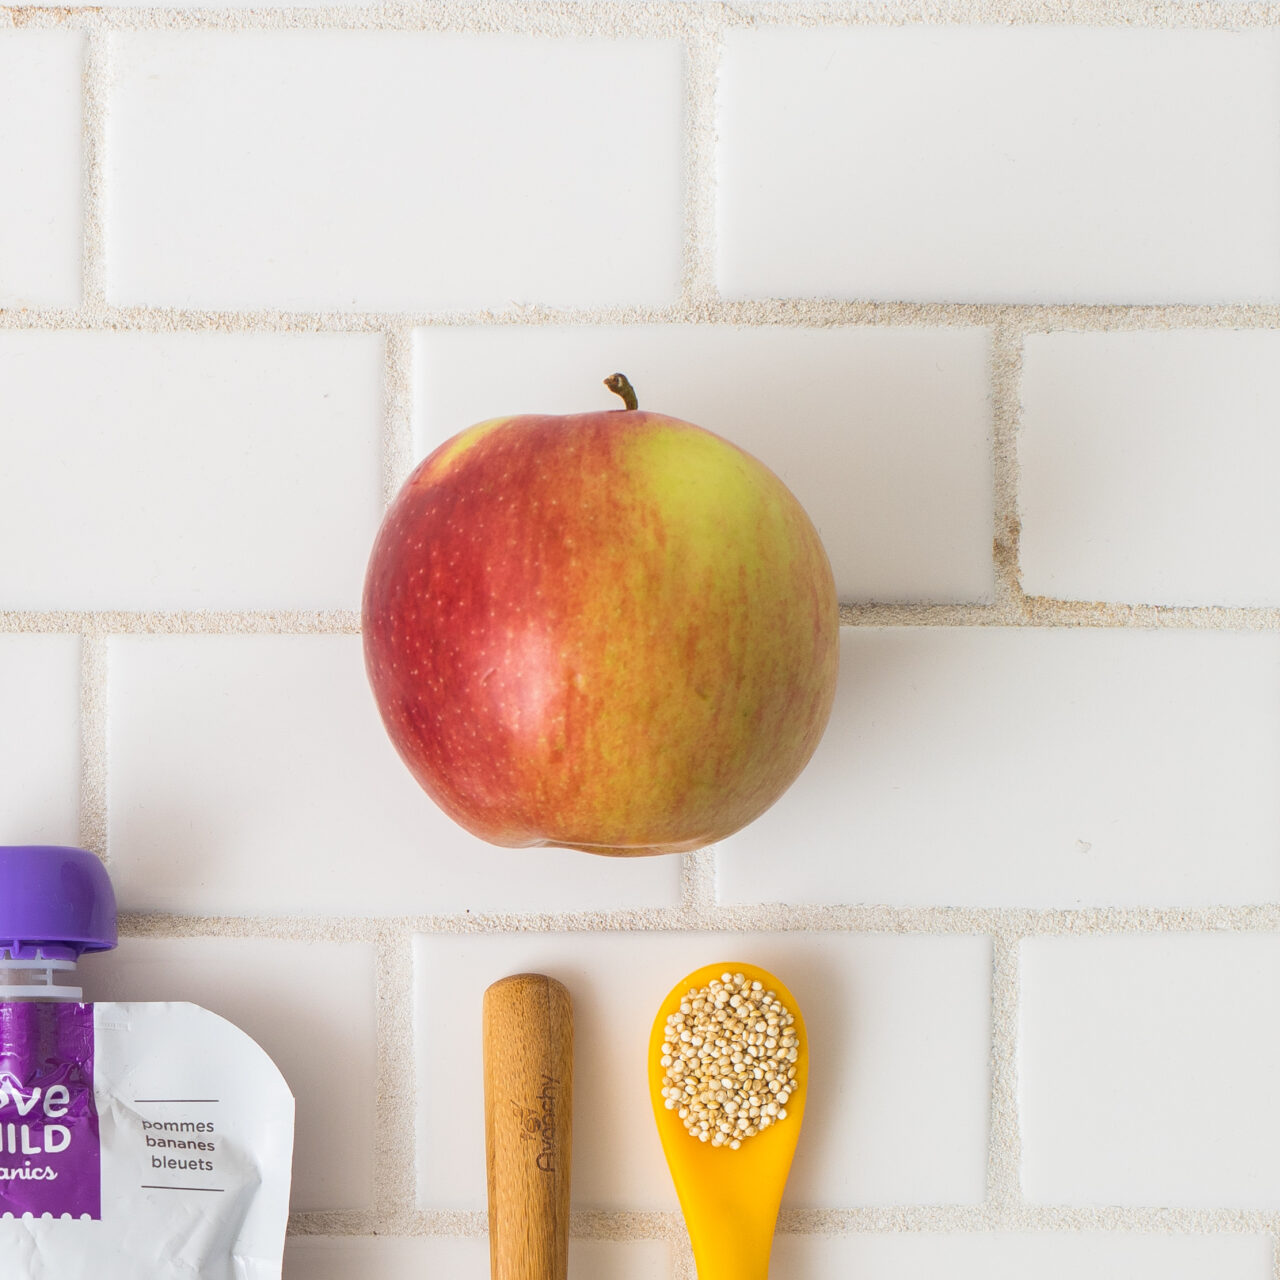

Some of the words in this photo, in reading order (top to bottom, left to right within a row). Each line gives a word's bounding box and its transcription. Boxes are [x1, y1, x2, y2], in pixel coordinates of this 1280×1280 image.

[142, 1120, 215, 1133] pommes
[535, 1073, 561, 1173] Avanchy
[145, 1135, 216, 1152] bananes
[151, 1155, 213, 1171] bleuets
